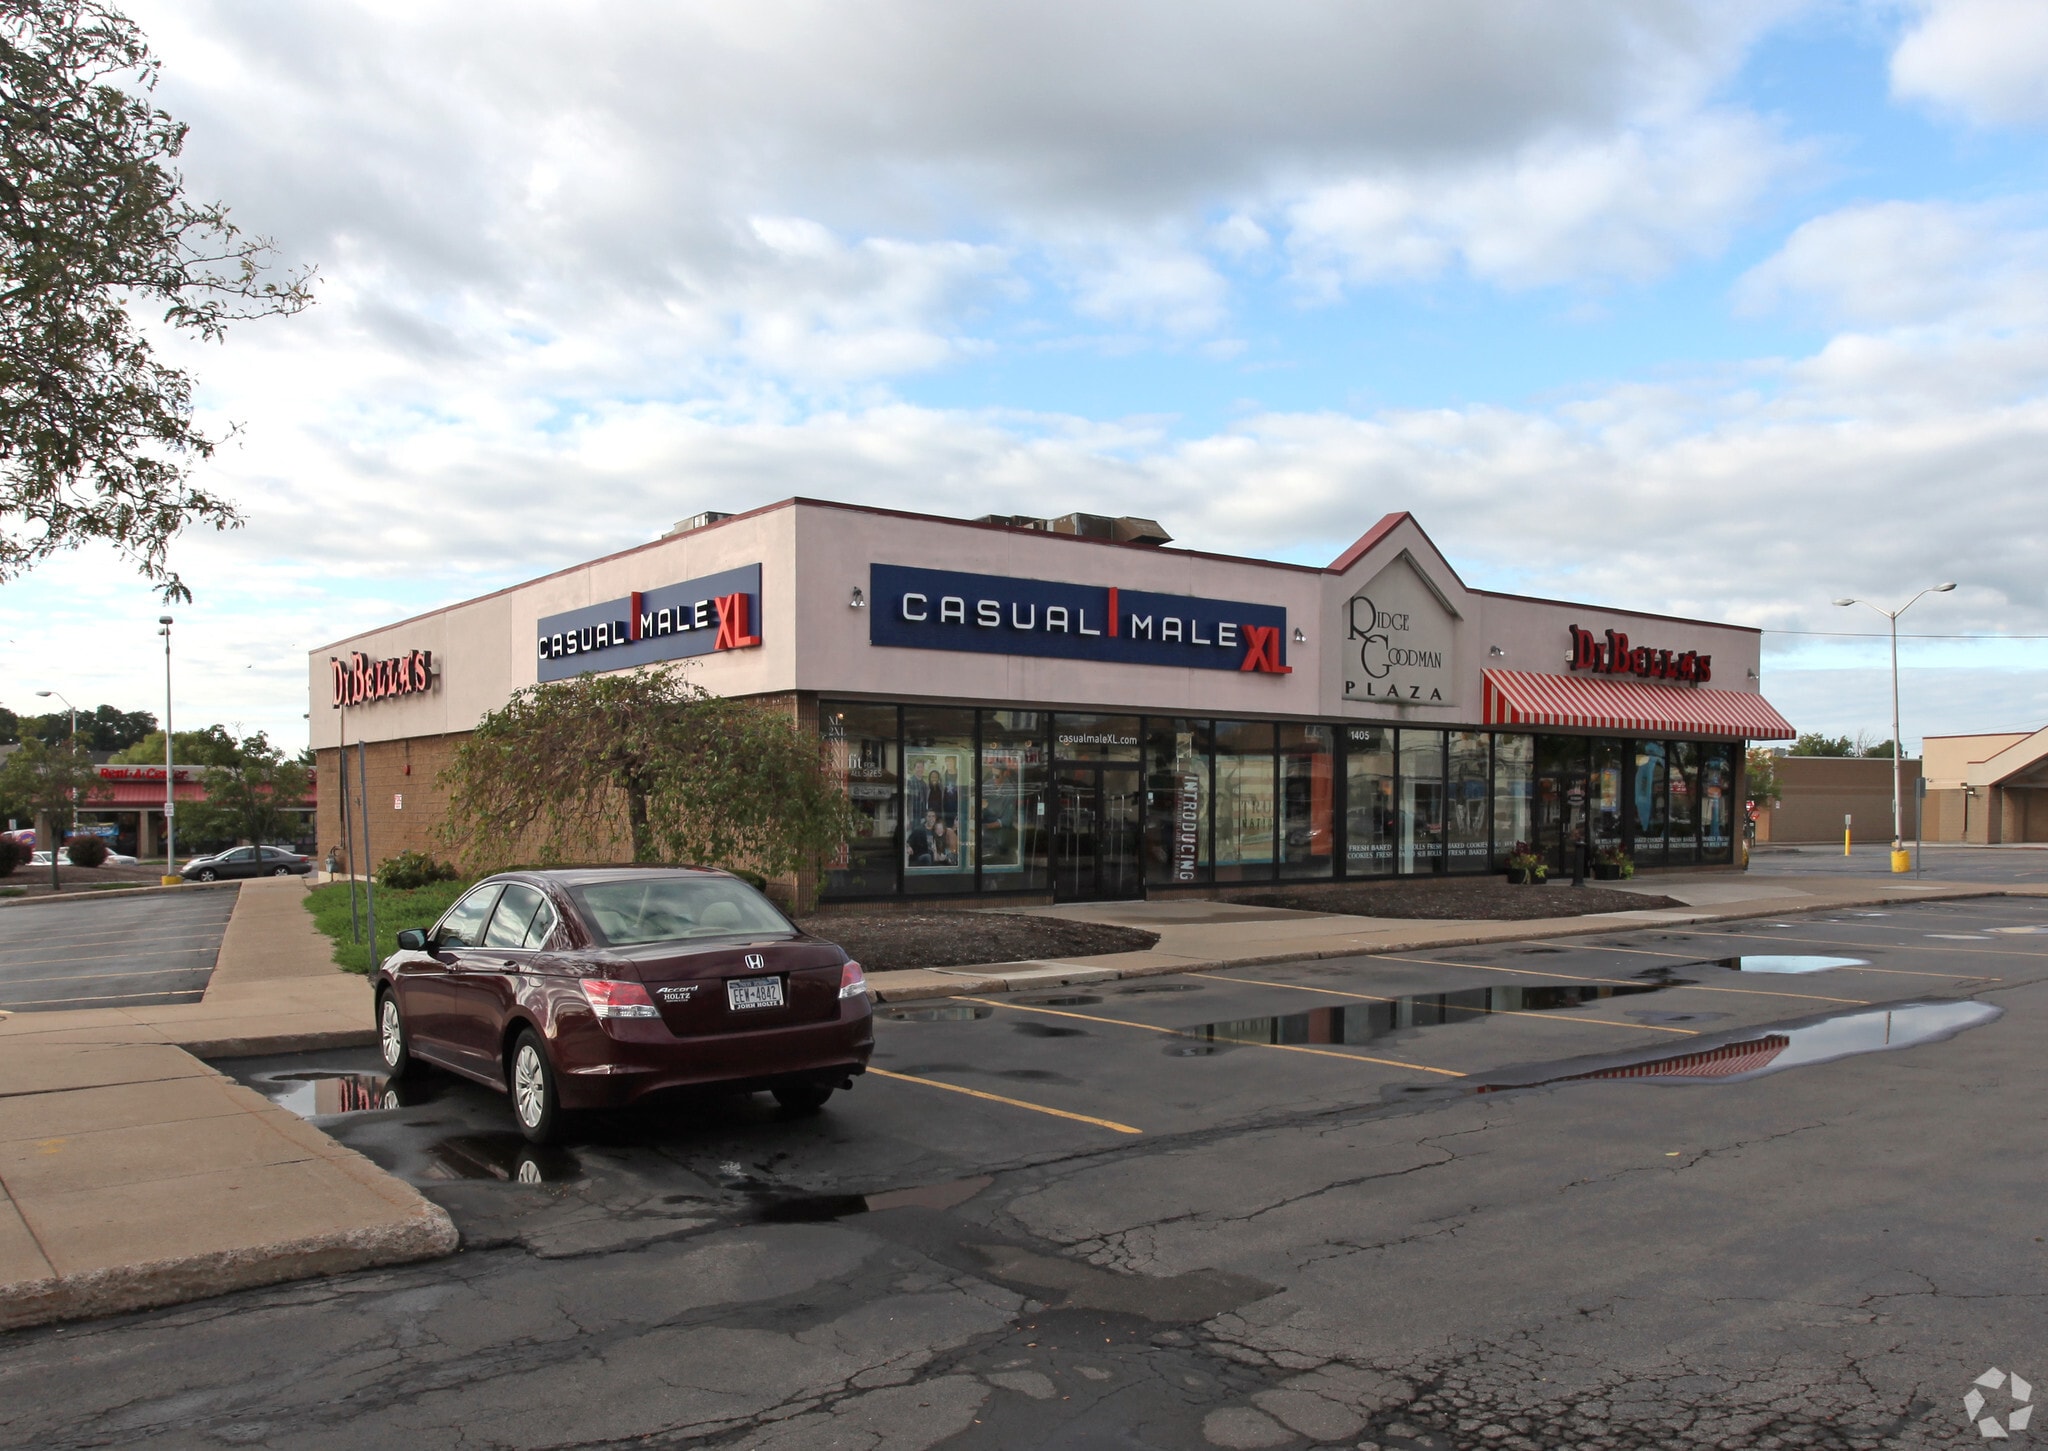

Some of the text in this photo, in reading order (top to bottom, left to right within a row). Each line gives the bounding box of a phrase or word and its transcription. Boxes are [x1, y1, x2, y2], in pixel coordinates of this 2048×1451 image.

[537, 592, 762, 660] CASUAL MALE XL
[1347, 596, 1410, 644] RIDGE
[902, 593, 1293, 674] CASUAL MALE XL
[1361, 634, 1442, 679] GOODMAN
[1345, 680, 1442, 701] PLAZA
[1058, 733, 1138, 745] casualmaleXL.com
[1351, 730, 1370, 740] 1405
[848, 753, 863, 769] fit
[851, 769, 883, 777] ALL SIZES
[1179, 775, 1199, 881] INTRODUCING
[656, 985, 698, 994] Accord
